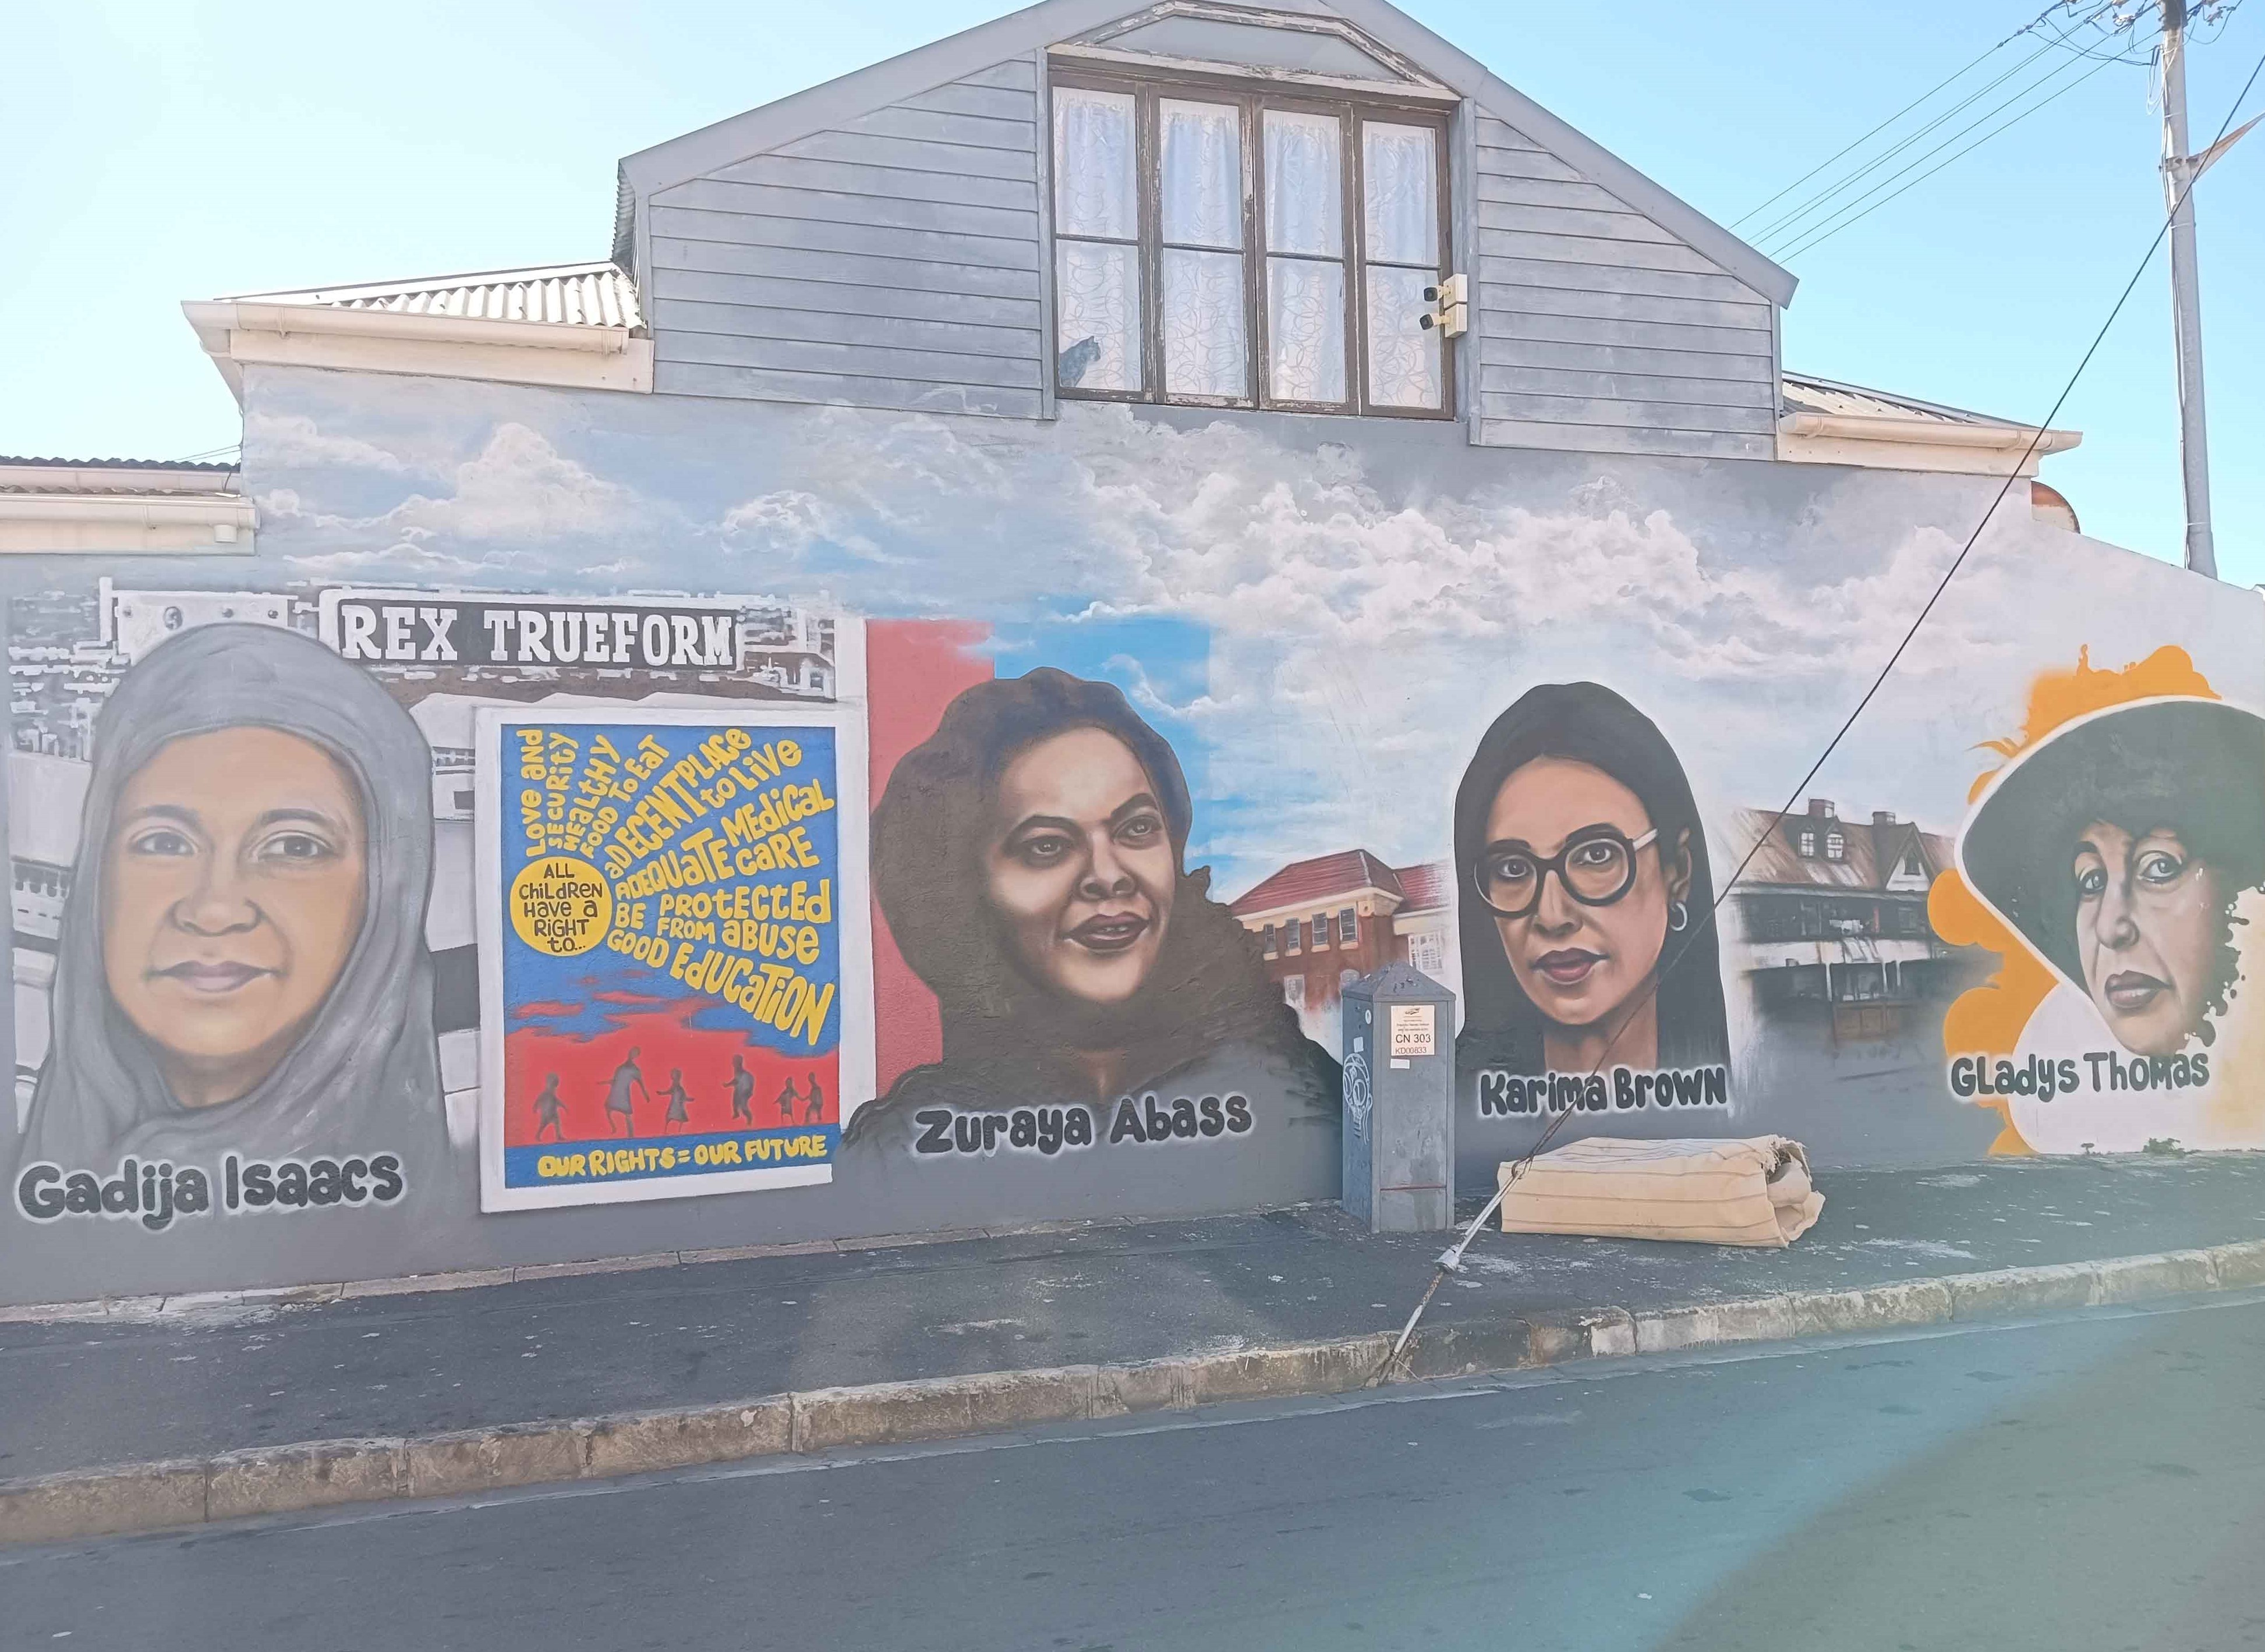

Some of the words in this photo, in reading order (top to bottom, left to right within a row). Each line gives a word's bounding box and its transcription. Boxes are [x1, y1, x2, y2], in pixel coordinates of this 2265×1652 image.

[341, 605, 459, 662] REX
[483, 609, 734, 667] TRUEFORM
[580, 806, 618, 859] FOOD
[543, 863, 575, 878] ALL
[583, 900, 598, 918] a
[615, 902, 646, 930] BE
[607, 929, 670, 969] GOOD
[657, 917, 716, 944] FROM
[1396, 1034, 1410, 1043] CN
[1414, 1034, 1431, 1043] 303
[1480, 1071, 1608, 1116] Karima
[914, 1106, 1093, 1155] Zuraya
[1109, 1095, 1254, 1144] Abass
[537, 1154, 586, 1178] OUR
[588, 1147, 677, 1177] RIGHTS
[693, 1140, 742, 1165] OUR
[744, 1135, 828, 1162] FUTURE
[17, 1156, 211, 1232] Gadija
[225, 1154, 404, 1210] Isaacs
